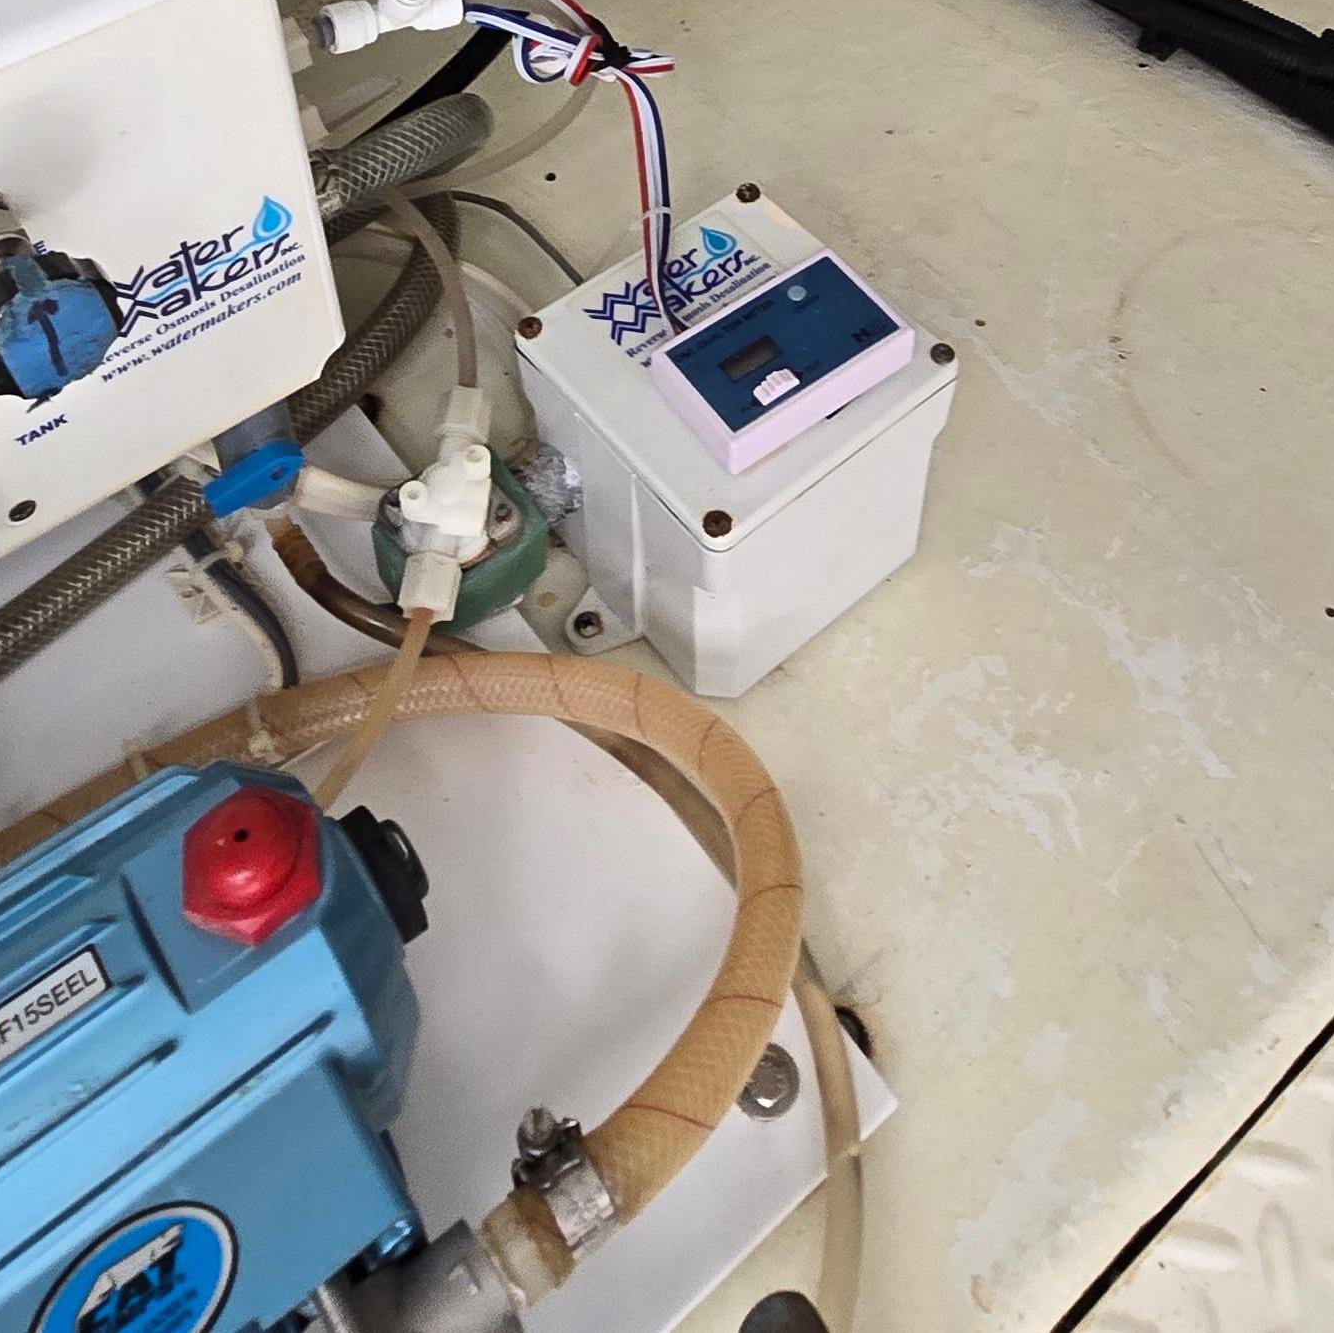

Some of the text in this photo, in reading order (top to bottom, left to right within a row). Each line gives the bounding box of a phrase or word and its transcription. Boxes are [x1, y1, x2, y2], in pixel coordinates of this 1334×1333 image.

[101, 272, 304, 383] www.watermakers.com
[104, 253, 306, 364] everse Osmosis Desalination
[13, 413, 69, 447] TANK
